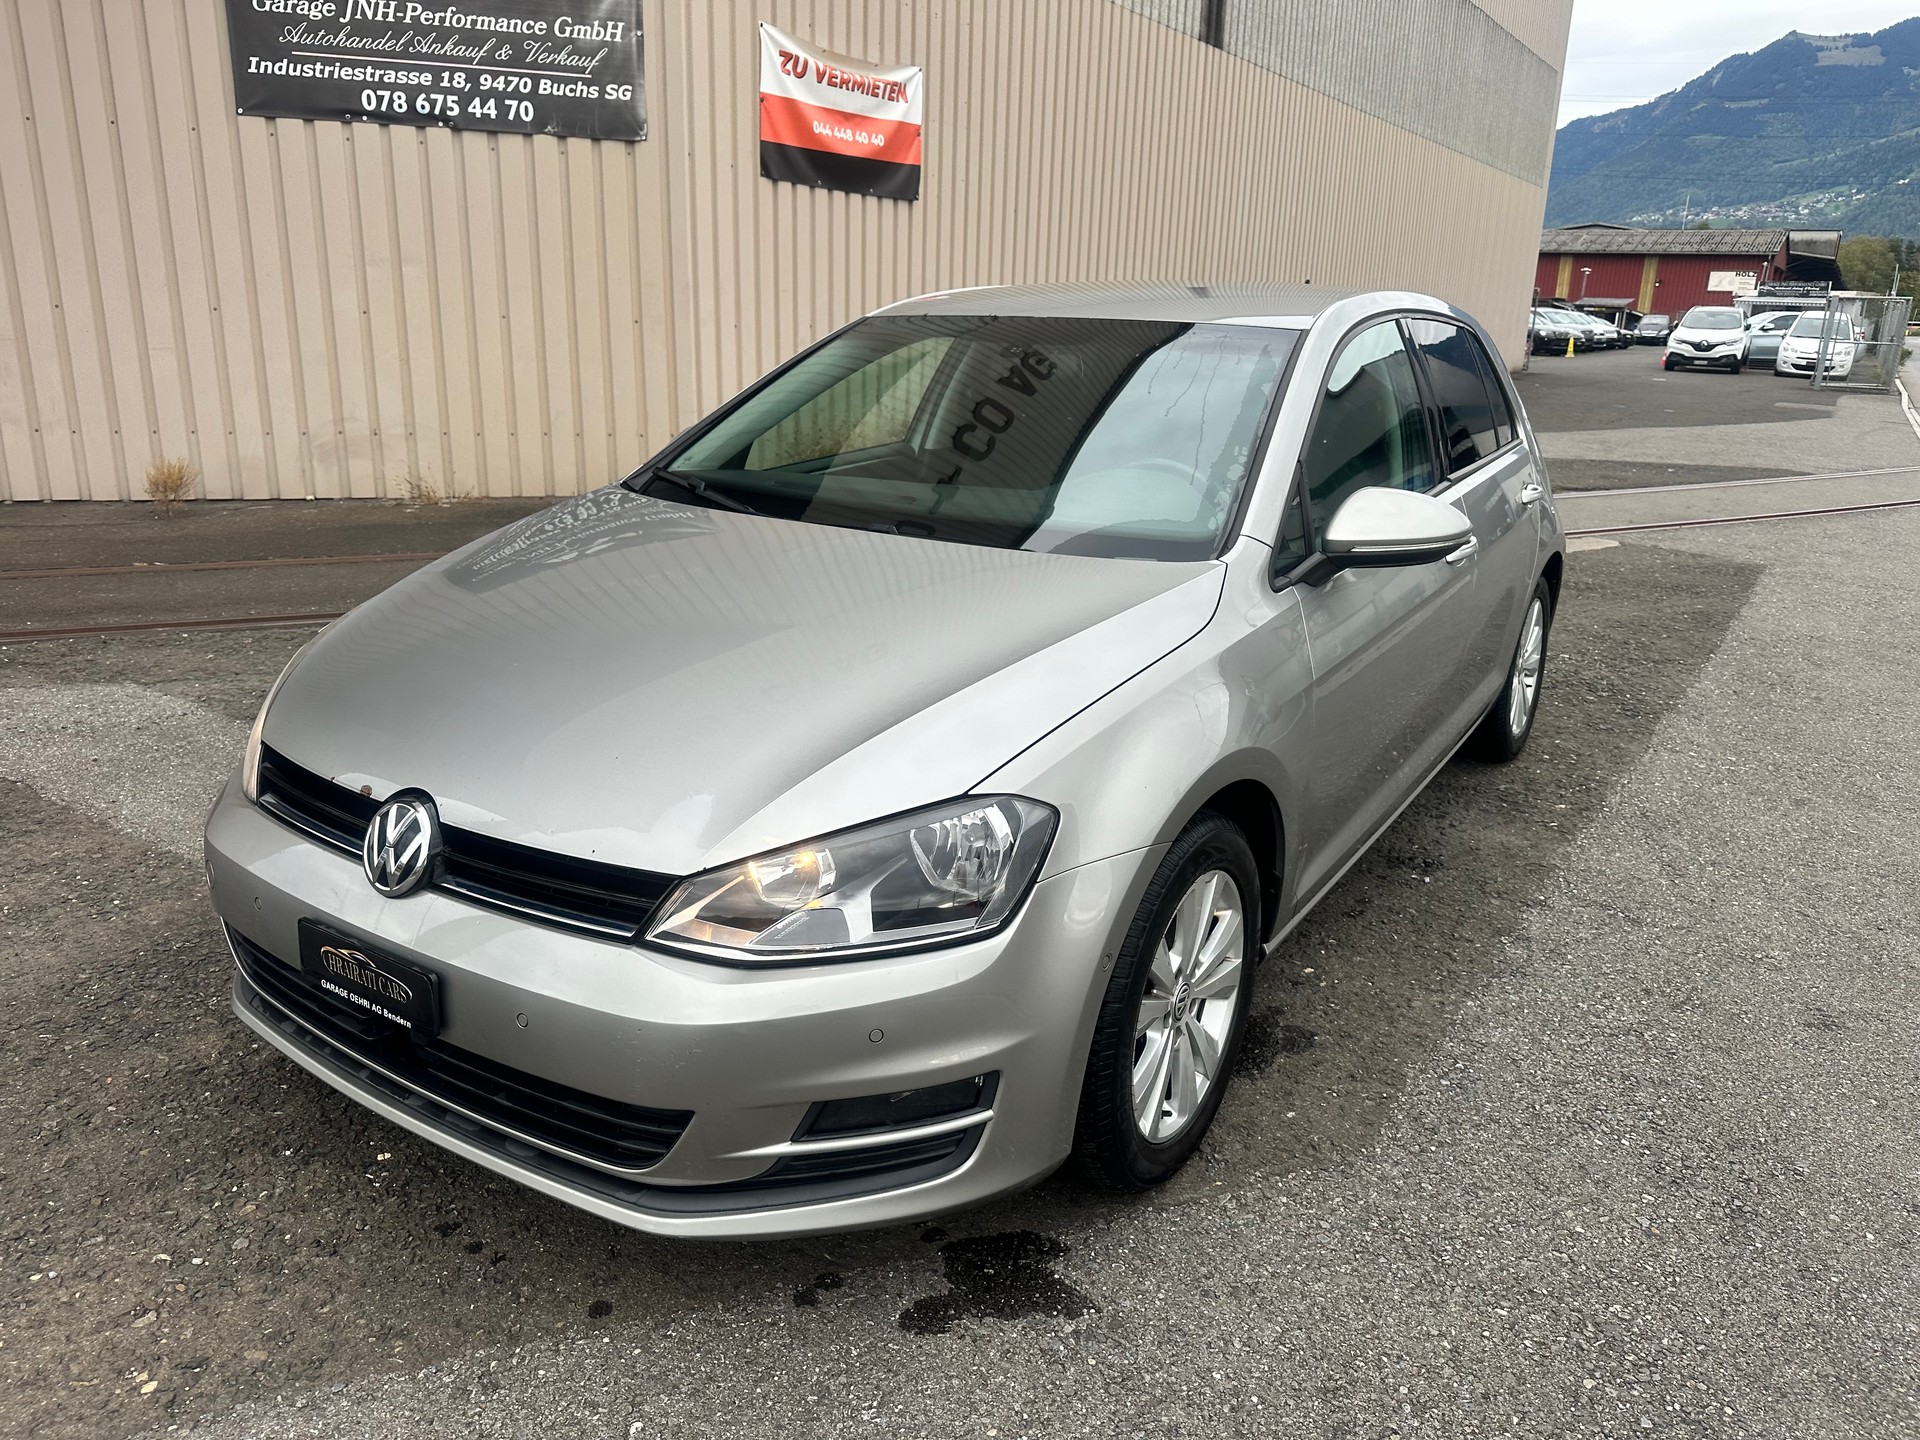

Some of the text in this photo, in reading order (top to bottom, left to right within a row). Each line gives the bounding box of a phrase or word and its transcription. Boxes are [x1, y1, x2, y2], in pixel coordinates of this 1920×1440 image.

[252, 0, 625, 42] Garage JNH-Performance GmbH
[278, 21, 608, 74] Autohandel Ankauf & Verkauf
[247, 57, 633, 101] Industriestrasse 18, 9470 Buchs SG
[778, 49, 909, 103] ZU VERMIETEN
[361, 88, 535, 122] 078 675 44 70
[813, 120, 885, 147] 044 448 40 40
[320, 979, 412, 1029] GARAGE OEHRI AG Bendern
[379, 976, 407, 1004] CARS
